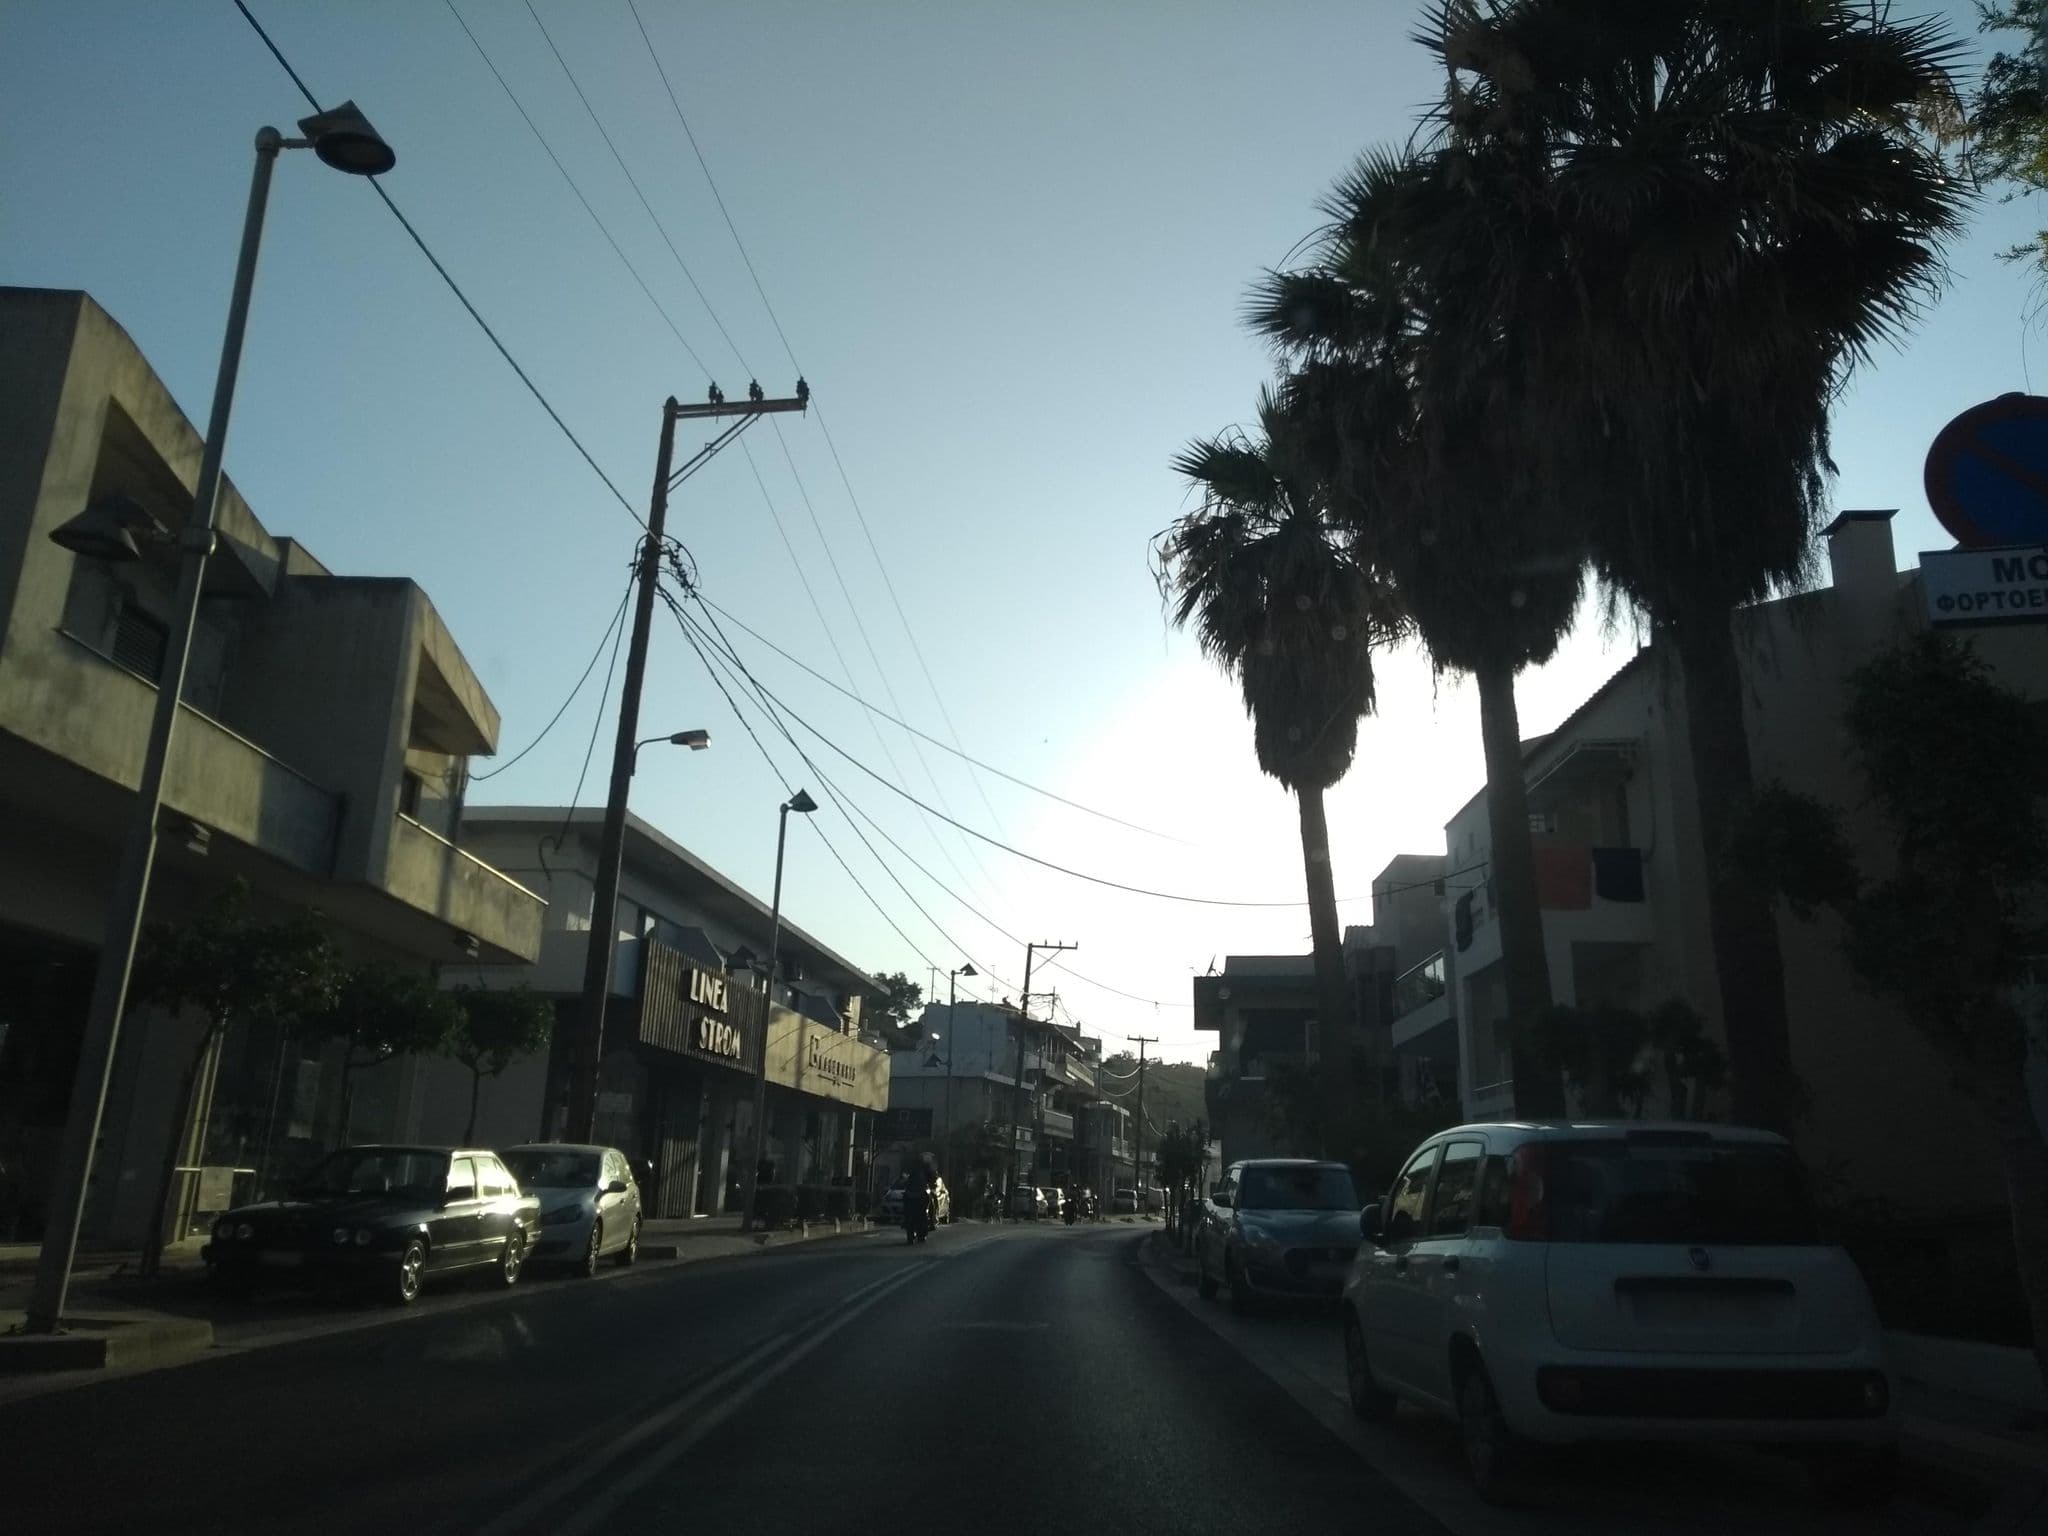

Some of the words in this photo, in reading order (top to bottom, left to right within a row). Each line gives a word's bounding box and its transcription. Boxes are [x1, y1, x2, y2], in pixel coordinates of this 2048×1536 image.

[1937, 588, 2048, 612] ΦΟΡΤΟΕ
[690, 968, 728, 1013] LINEA
[699, 1016, 741, 1059] STROM
